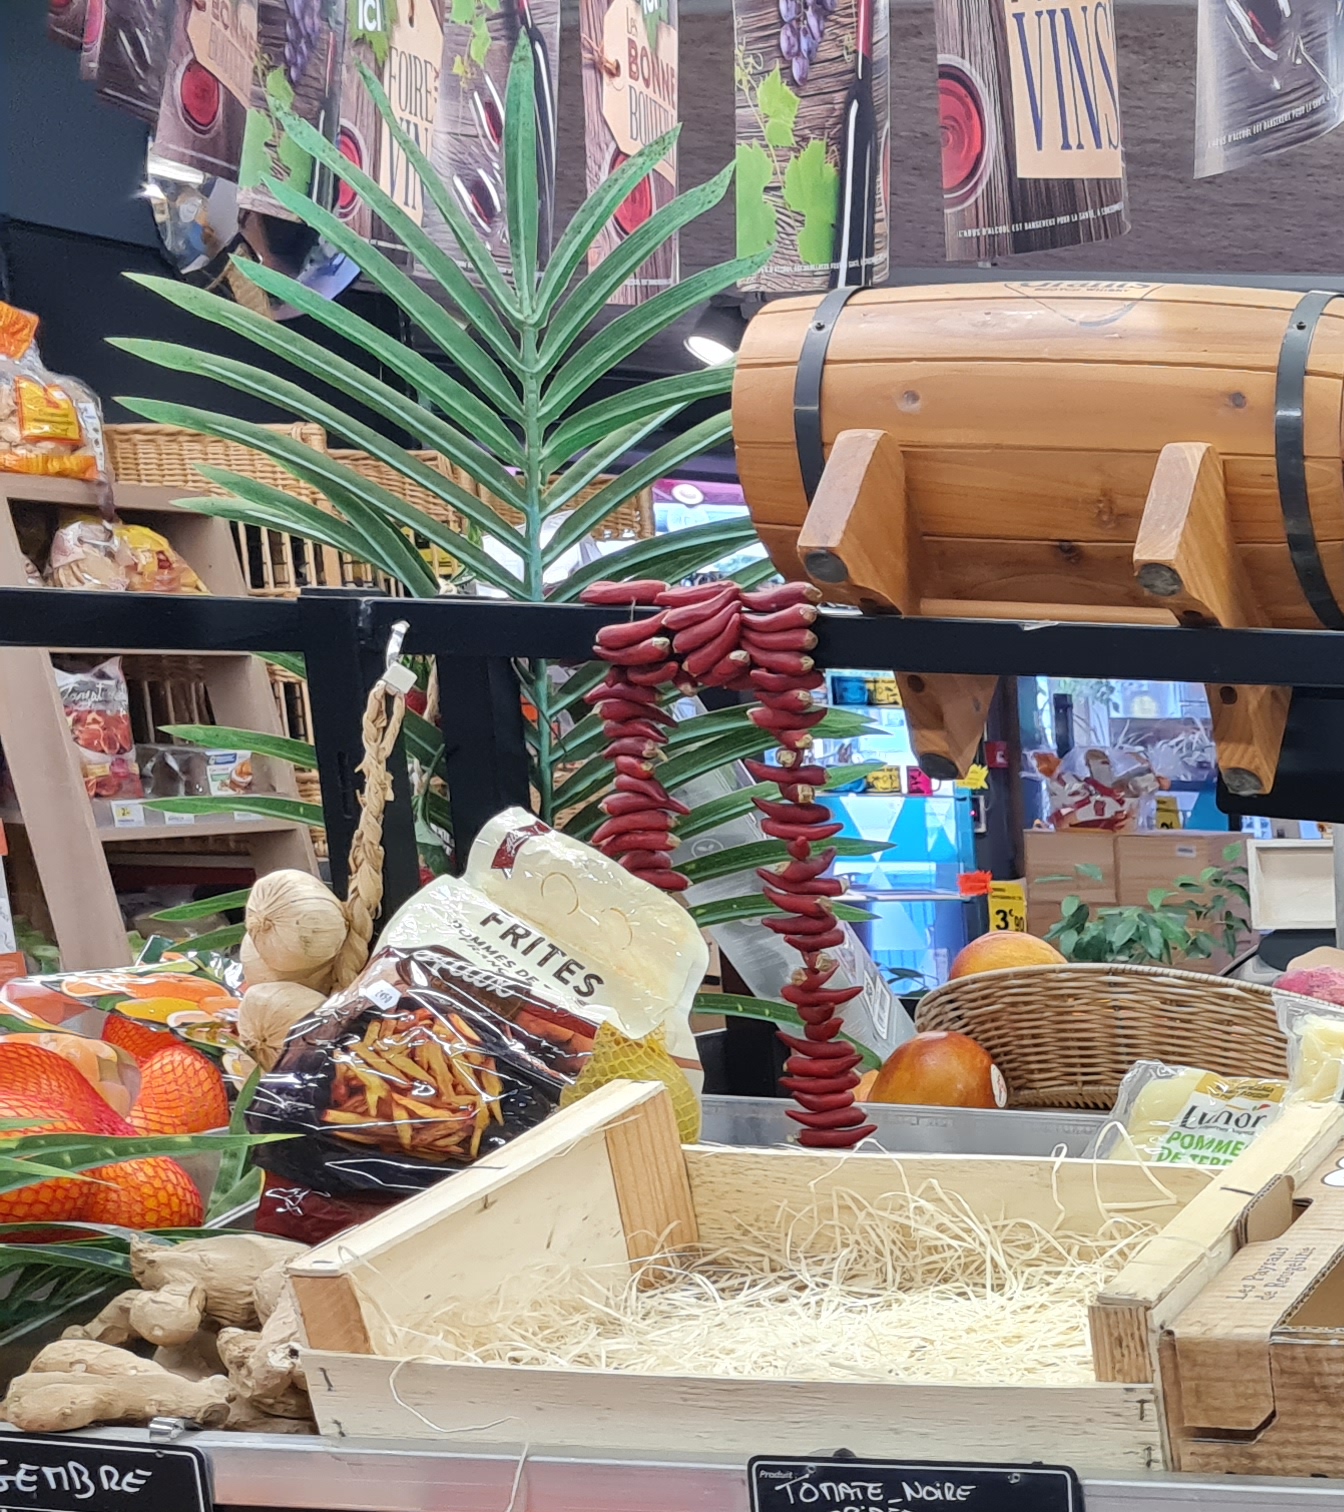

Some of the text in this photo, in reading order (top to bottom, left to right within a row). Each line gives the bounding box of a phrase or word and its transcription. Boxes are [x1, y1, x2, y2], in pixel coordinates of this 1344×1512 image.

[1013, 3, 1121, 151] VINS
[479, 911, 605, 998] FRITES
[1180, 1103, 1268, 1129] Lunor
